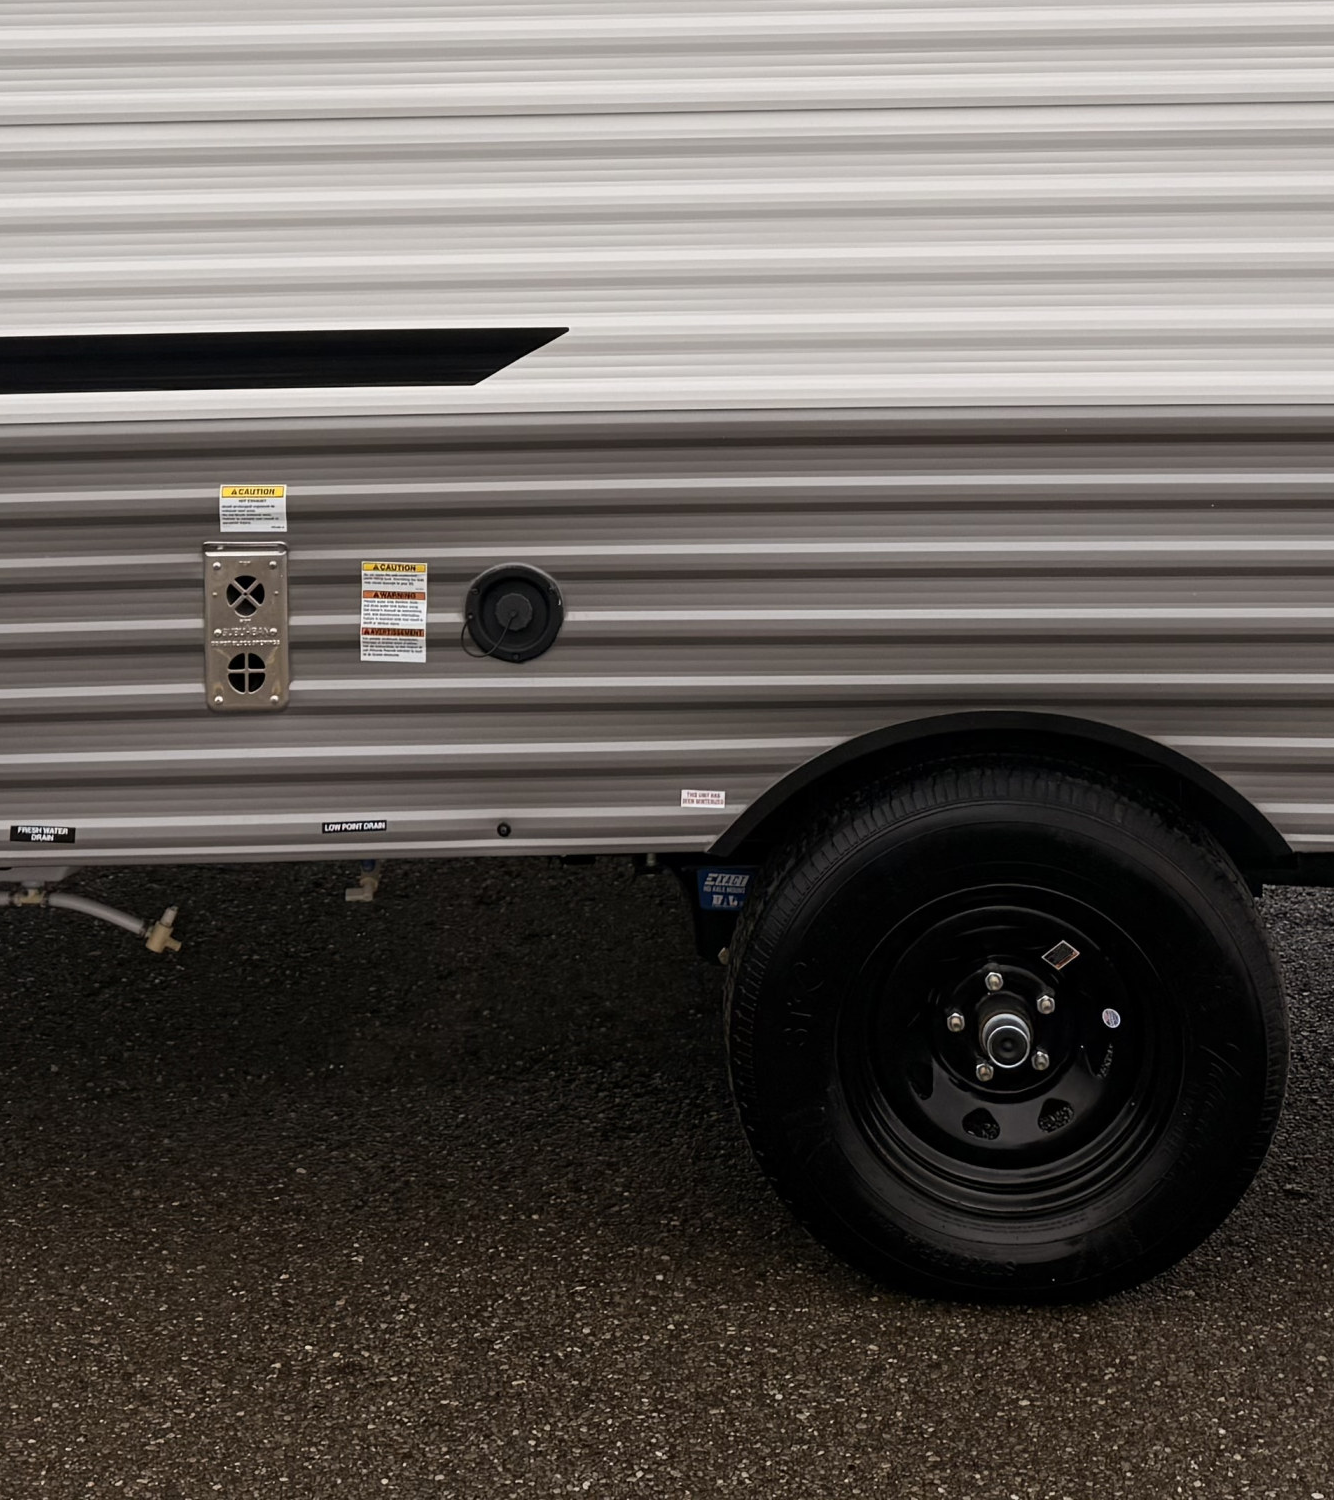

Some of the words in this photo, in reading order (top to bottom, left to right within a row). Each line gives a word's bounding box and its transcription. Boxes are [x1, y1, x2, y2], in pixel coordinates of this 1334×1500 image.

[17, 826, 42, 834] FRESH
[43, 827, 68, 835] WATER
[324, 823, 341, 831] LOW
[342, 823, 362, 831] POINT
[363, 821, 385, 830] DRAIN
[31, 833, 54, 841] DRAIN
